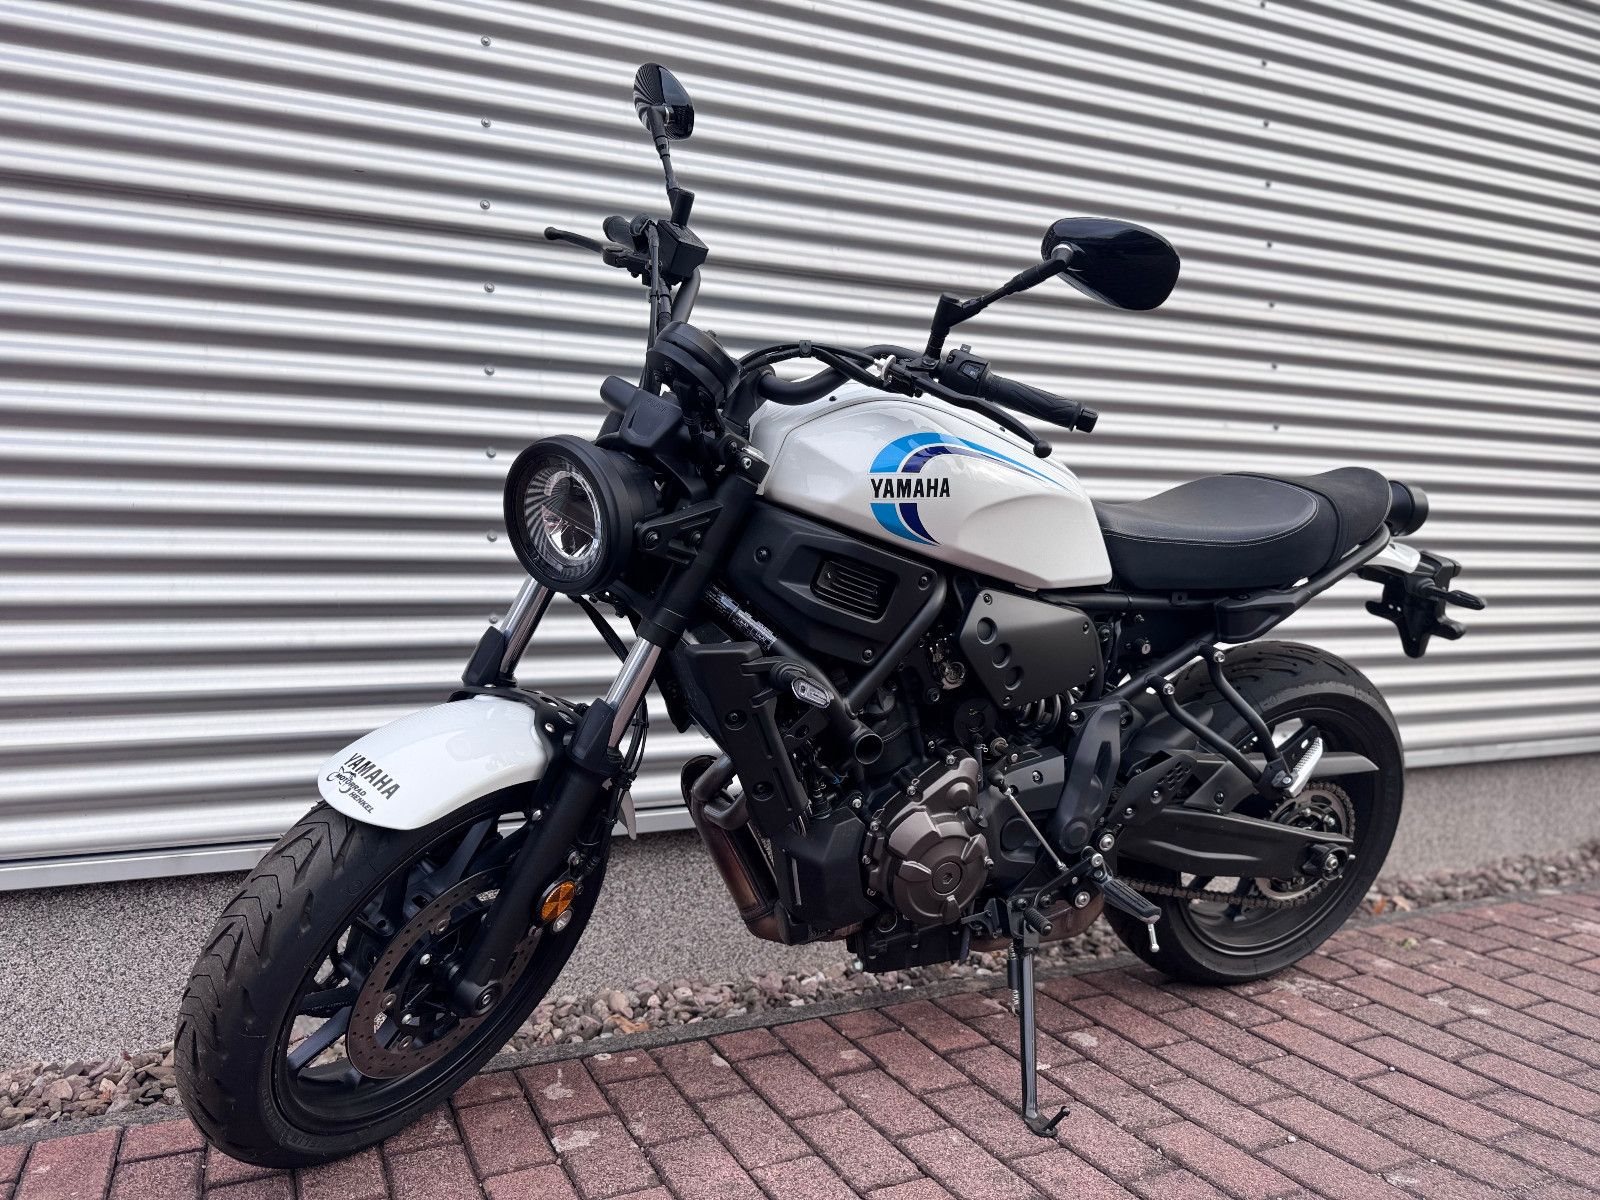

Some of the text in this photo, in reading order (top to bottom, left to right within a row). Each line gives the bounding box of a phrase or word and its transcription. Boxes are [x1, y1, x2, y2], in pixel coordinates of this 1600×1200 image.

[871, 478, 950, 498] YAMAHA
[336, 773, 367, 796] MOTORRAD
[344, 752, 400, 800] YAMAHA
[349, 791, 374, 813] HENKEL
